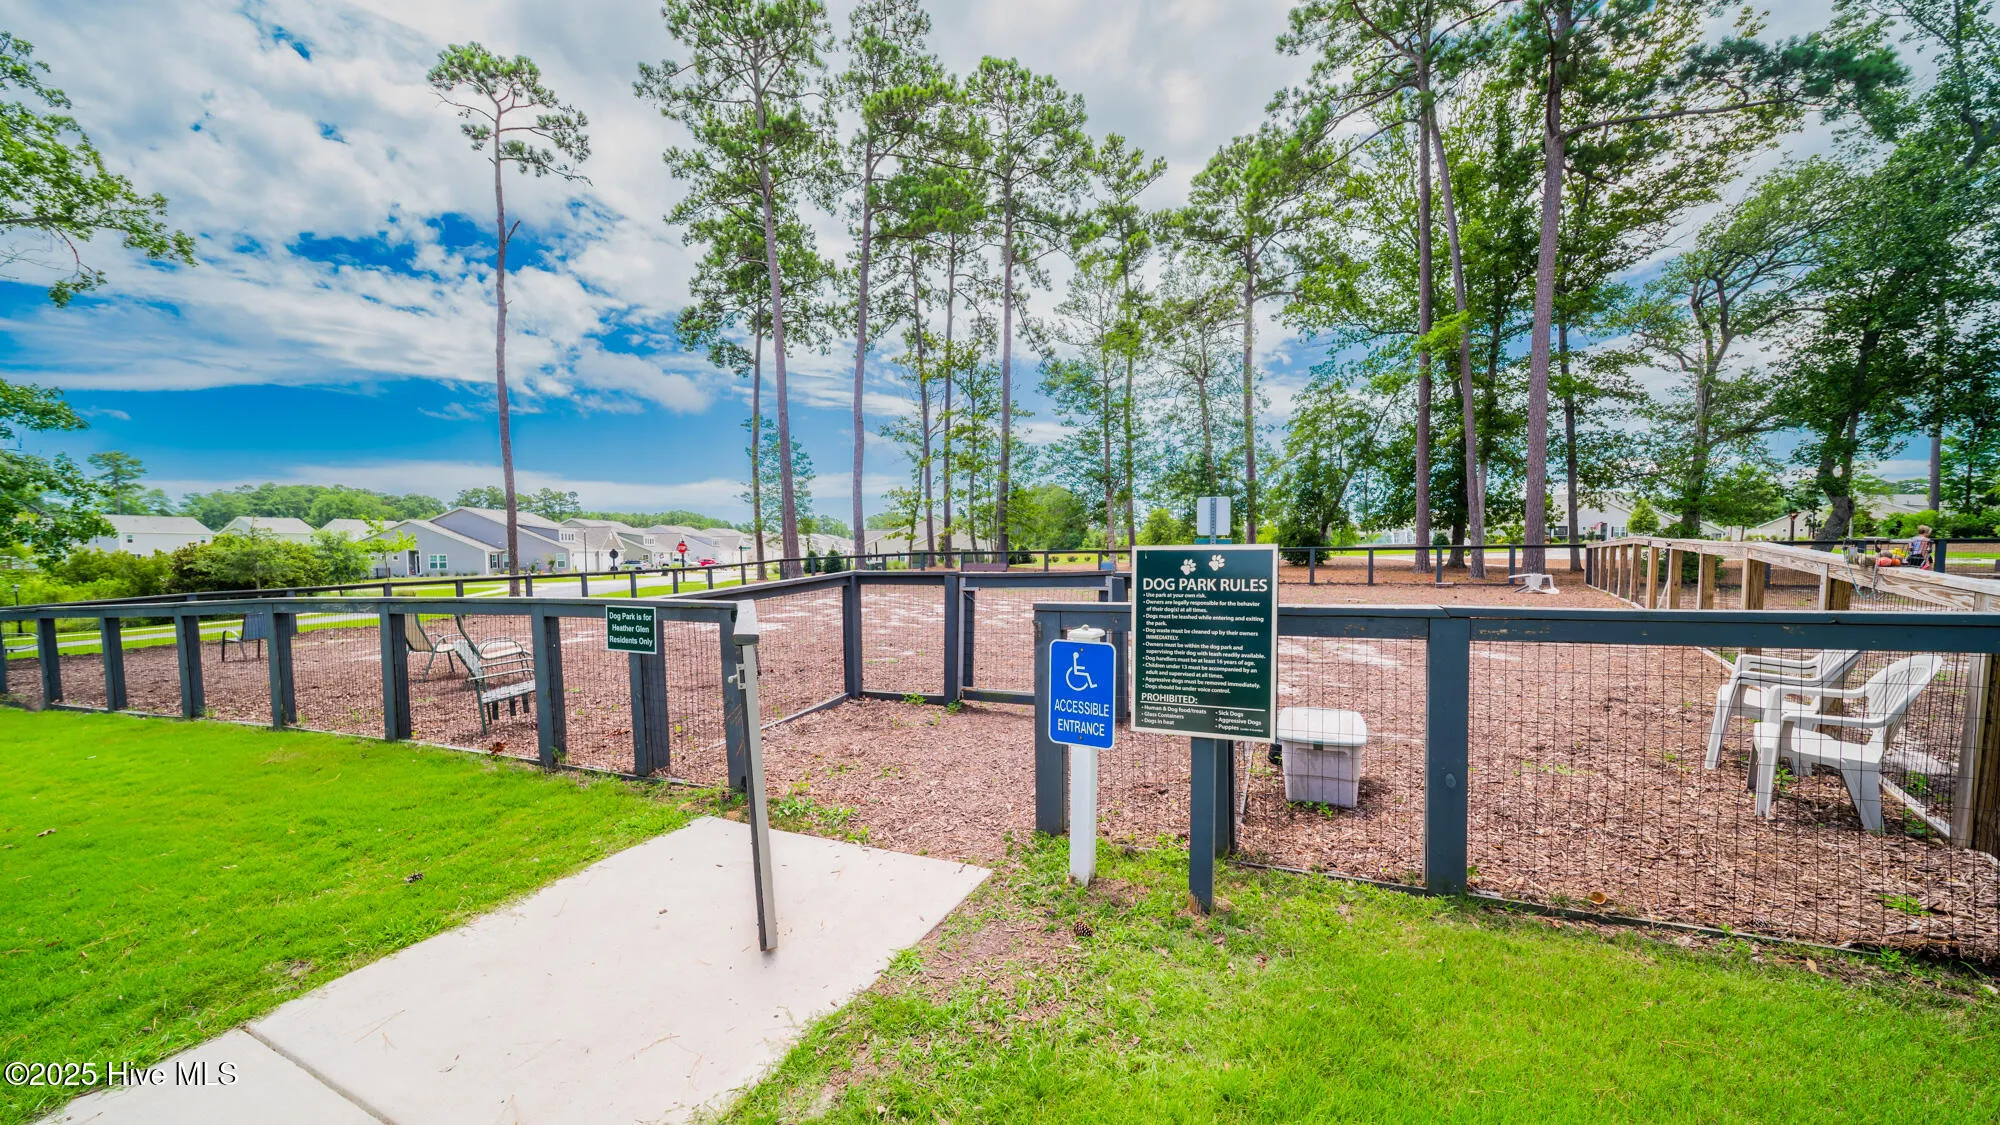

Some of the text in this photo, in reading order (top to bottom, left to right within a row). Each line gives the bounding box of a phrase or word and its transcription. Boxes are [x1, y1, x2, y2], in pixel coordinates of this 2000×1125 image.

[1143, 578, 1267, 591] DOG PARK RULES
[609, 612, 621, 621] Dog
[612, 624, 634, 632] Heather
[609, 636, 652, 647] Residents Only
[1142, 693, 1198, 704] PROHIBITED:
[1055, 699, 1109, 717] ACCESSIBLE
[1058, 718, 1104, 736] ENTRANCE
